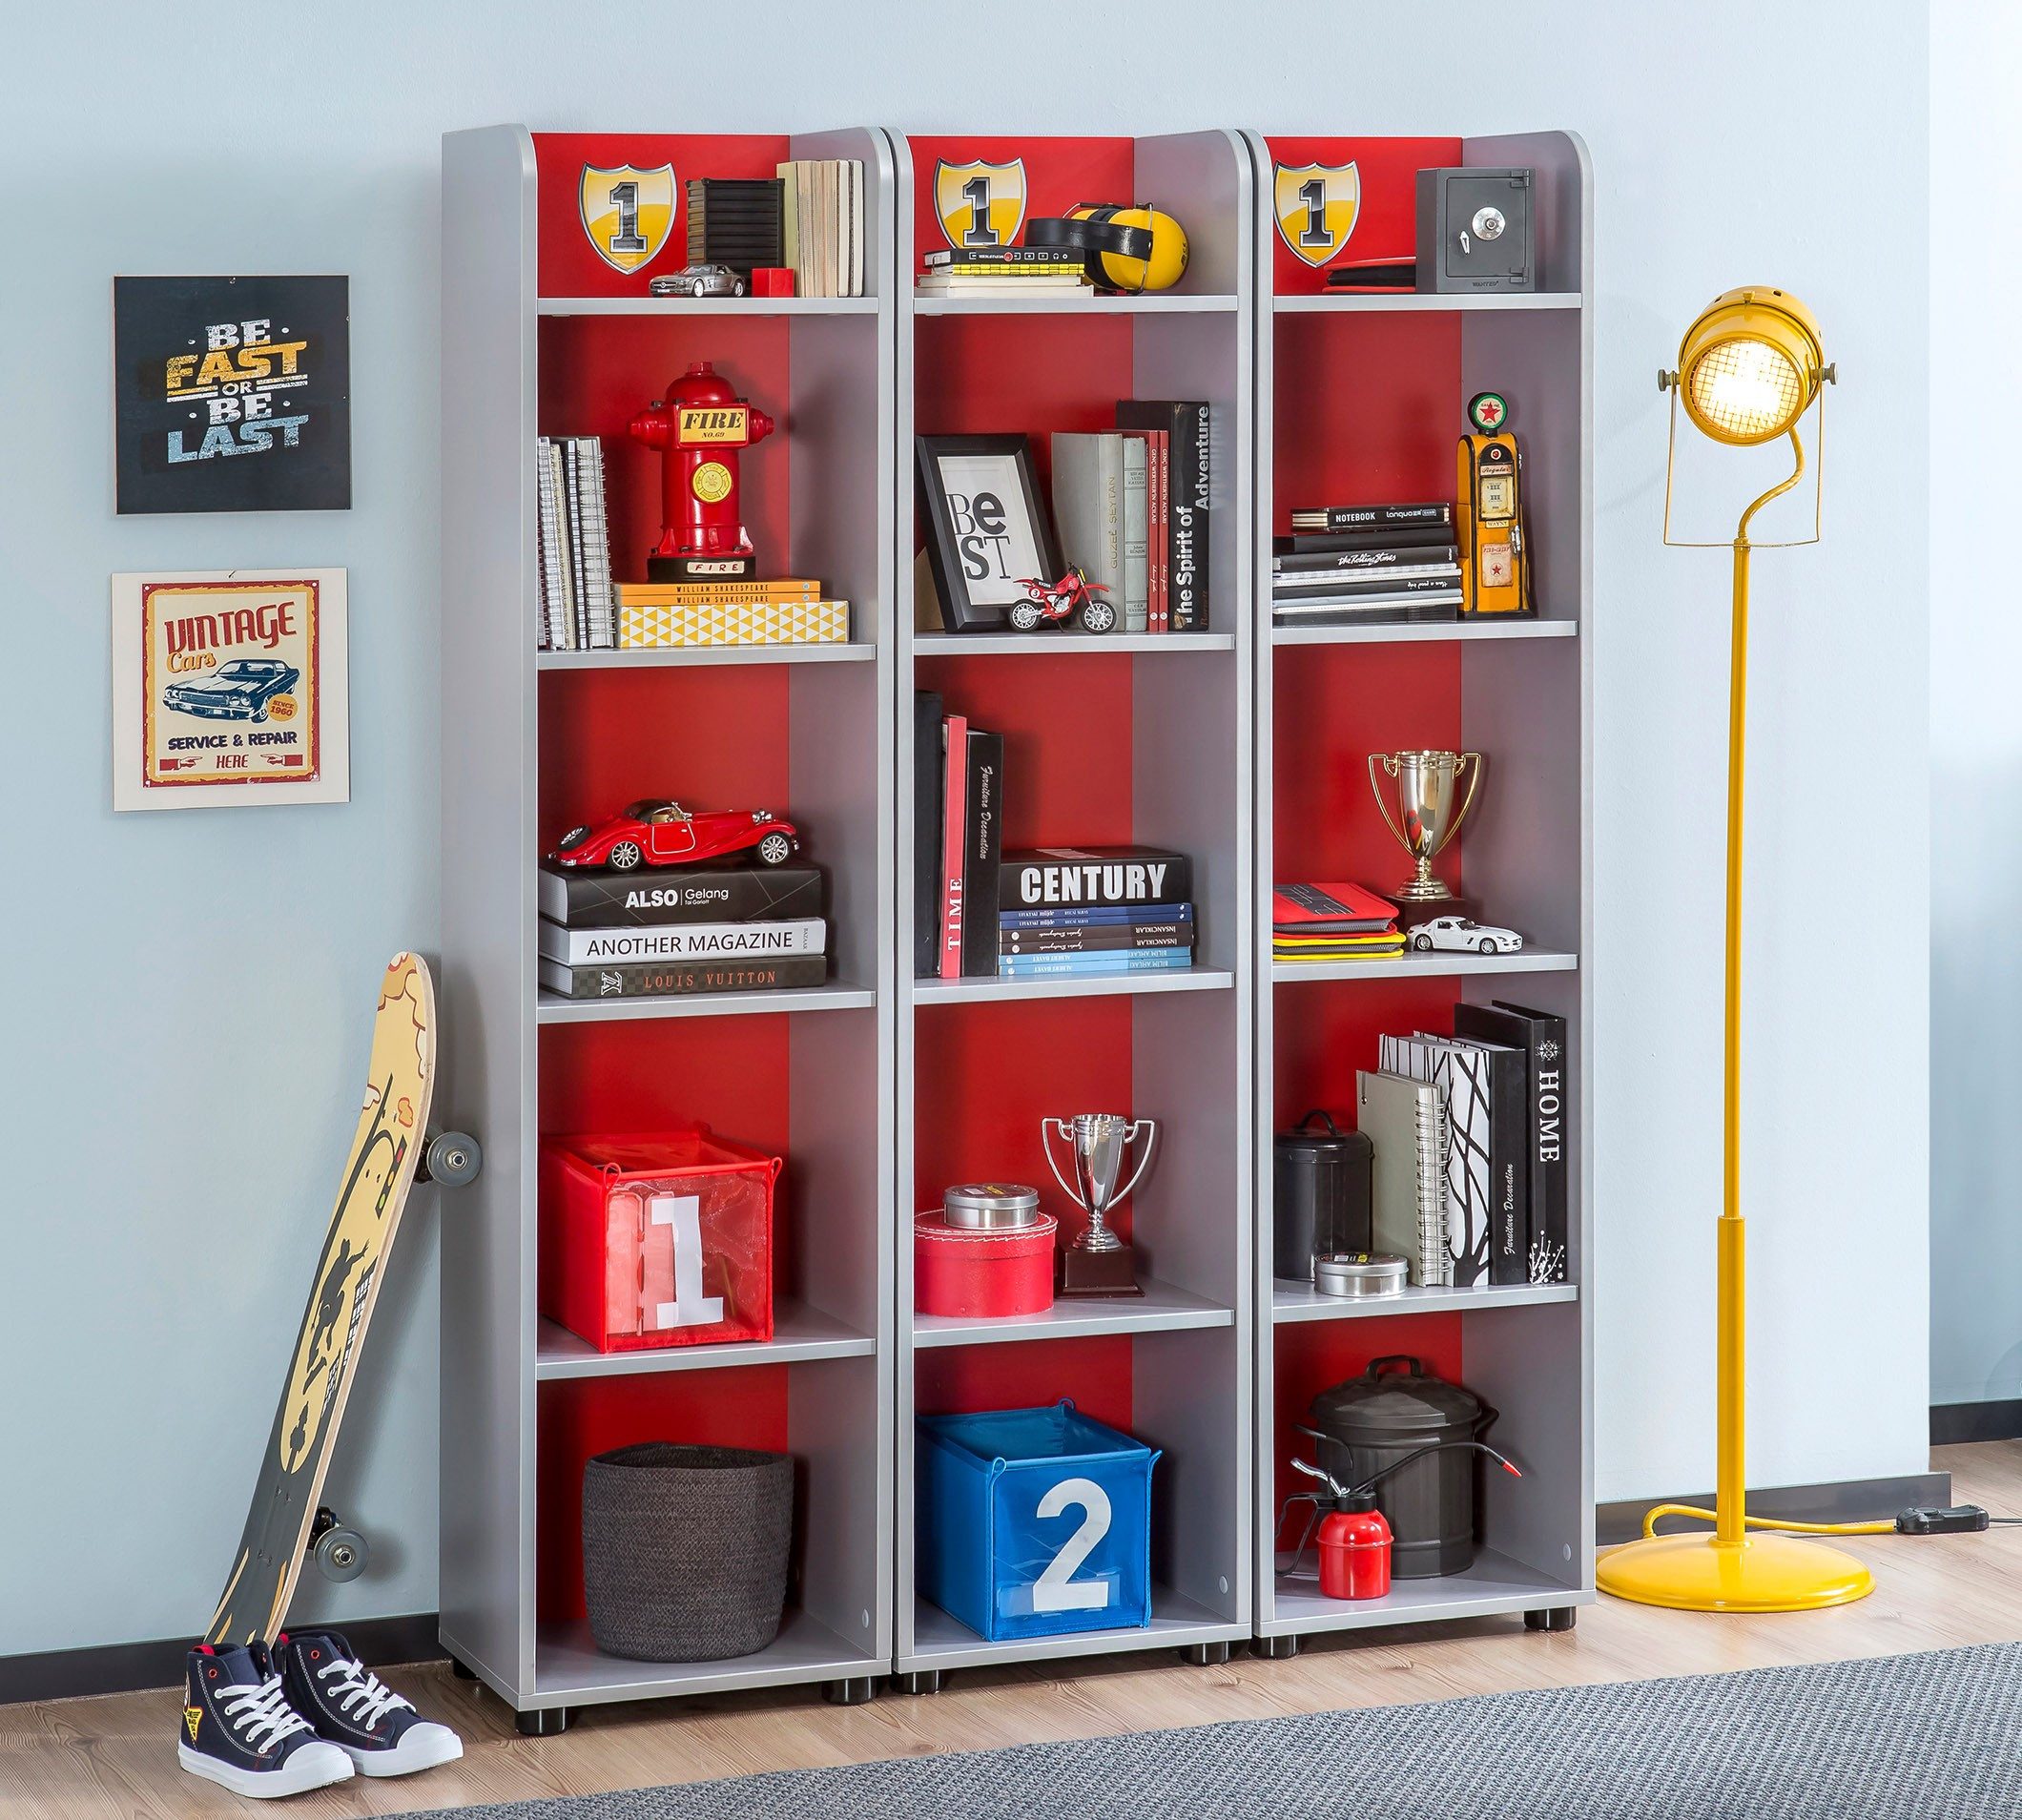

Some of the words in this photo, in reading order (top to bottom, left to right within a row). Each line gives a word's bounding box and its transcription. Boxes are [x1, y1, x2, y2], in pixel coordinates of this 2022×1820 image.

[609, 181, 648, 253] 1
[962, 176, 999, 247] 1
[1299, 179, 1334, 247] 1
[205, 319, 270, 351] BE
[166, 341, 307, 389] FAST
[222, 381, 252, 396] OR
[206, 393, 272, 425] BE
[683, 411, 744, 430] FIRE
[167, 414, 309, 463] LAST
[1195, 406, 1210, 511] Adventure
[946, 492, 1007, 535] Be
[1176, 506, 1193, 527] of
[1335, 512, 1376, 522] NOTEBOOK
[695, 563, 739, 571] FIRE
[961, 535, 1011, 580] ST
[1176, 530, 1196, 585] Spirit
[164, 601, 297, 655] VINTAGE
[166, 651, 216, 674] Cars
[270, 706, 293, 717] 1960
[272, 700, 294, 709] SINCE
[168, 734, 227, 750] SERVICE
[233, 734, 244, 747] &
[248, 732, 297, 746] REPAIR
[216, 755, 249, 768] HERE
[625, 889, 678, 909] ALSO
[685, 888, 729, 901] Gelang
[1021, 864, 1167, 903] CENTURY
[948, 878, 963, 951] TIME
[587, 936, 681, 956] ANOTHER
[689, 931, 793, 951] MAGAZINE
[644, 974, 694, 989] LOUIS
[706, 971, 776, 985] VUITTON
[1539, 1070, 1560, 1163] HOME
[651, 1195, 723, 1329] 1
[1033, 1478, 1112, 1612] 2
